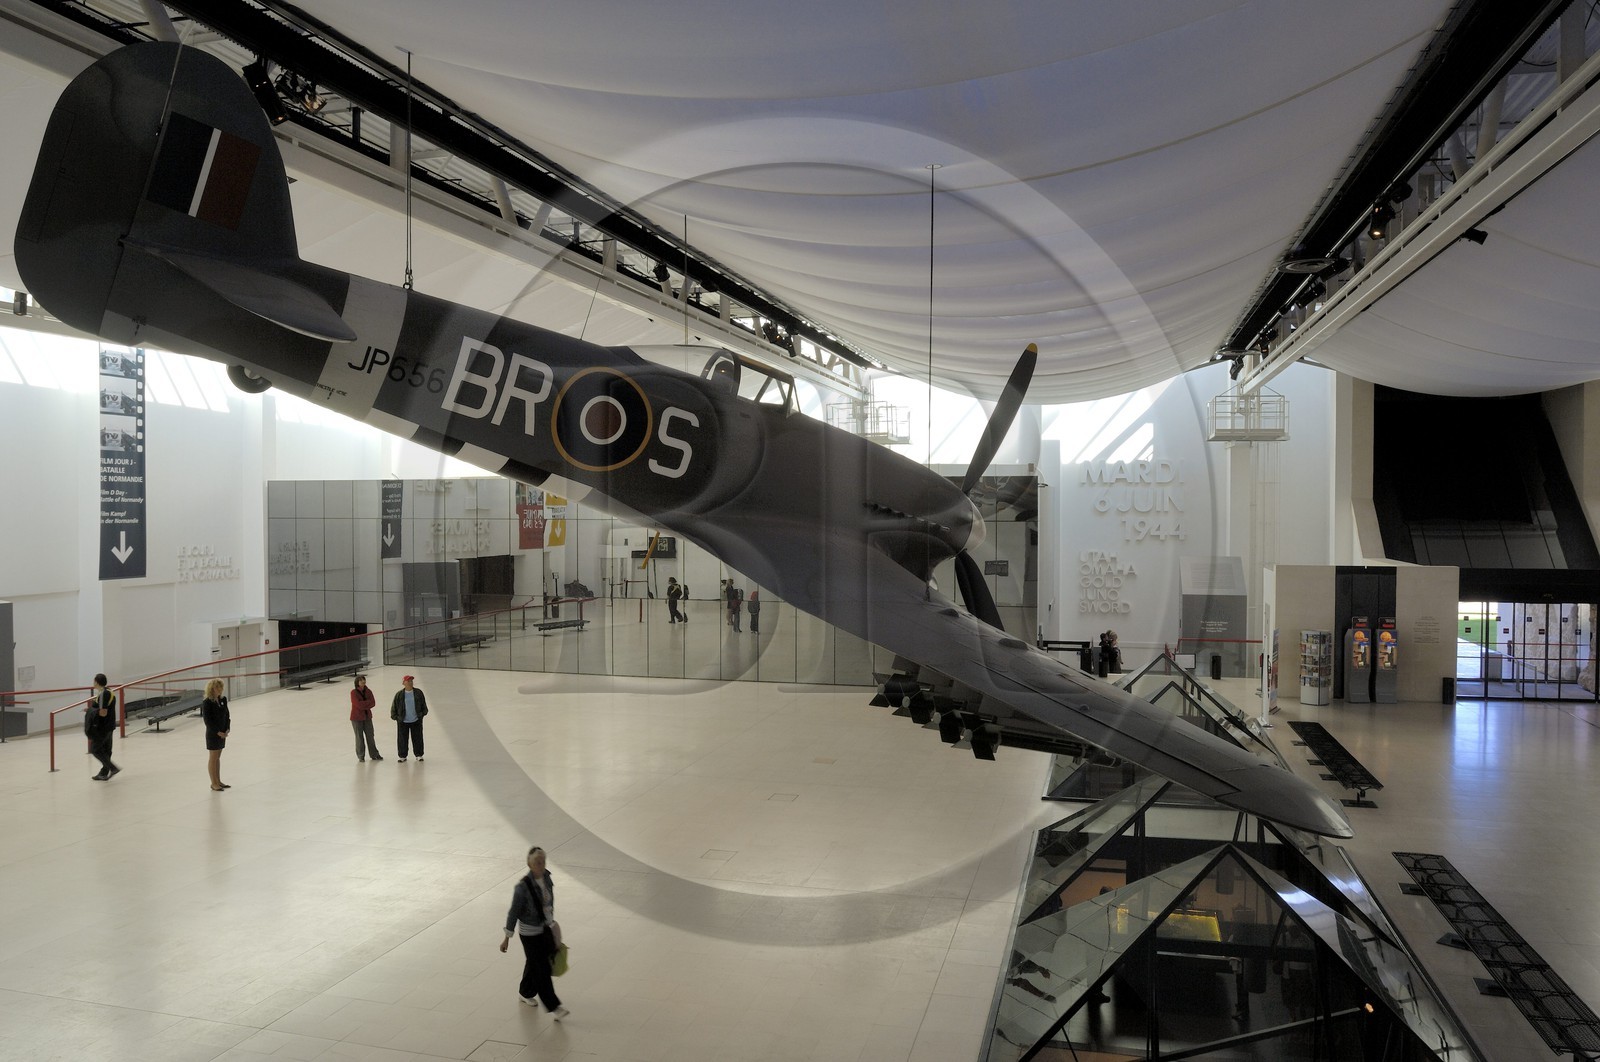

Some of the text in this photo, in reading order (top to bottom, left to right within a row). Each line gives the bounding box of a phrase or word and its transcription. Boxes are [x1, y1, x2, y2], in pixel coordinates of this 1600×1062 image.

[347, 345, 446, 394] JP656
[441, 335, 701, 479] BR S
[1080, 460, 1185, 484] MARDI
[108, 475, 143, 483] NORMANDIE
[115, 489, 125, 497] Day
[1094, 488, 1185, 513] 6 JUIN
[110, 510, 126, 518] Kampf
[1120, 520, 1187, 541] 1944
[1080, 551, 1118, 563] UTAH
[1080, 561, 1138, 576] OMAHA
[1080, 575, 1122, 588] GOLD
[1080, 588, 1120, 601] JUNO
[1080, 600, 1132, 613] SWORD
